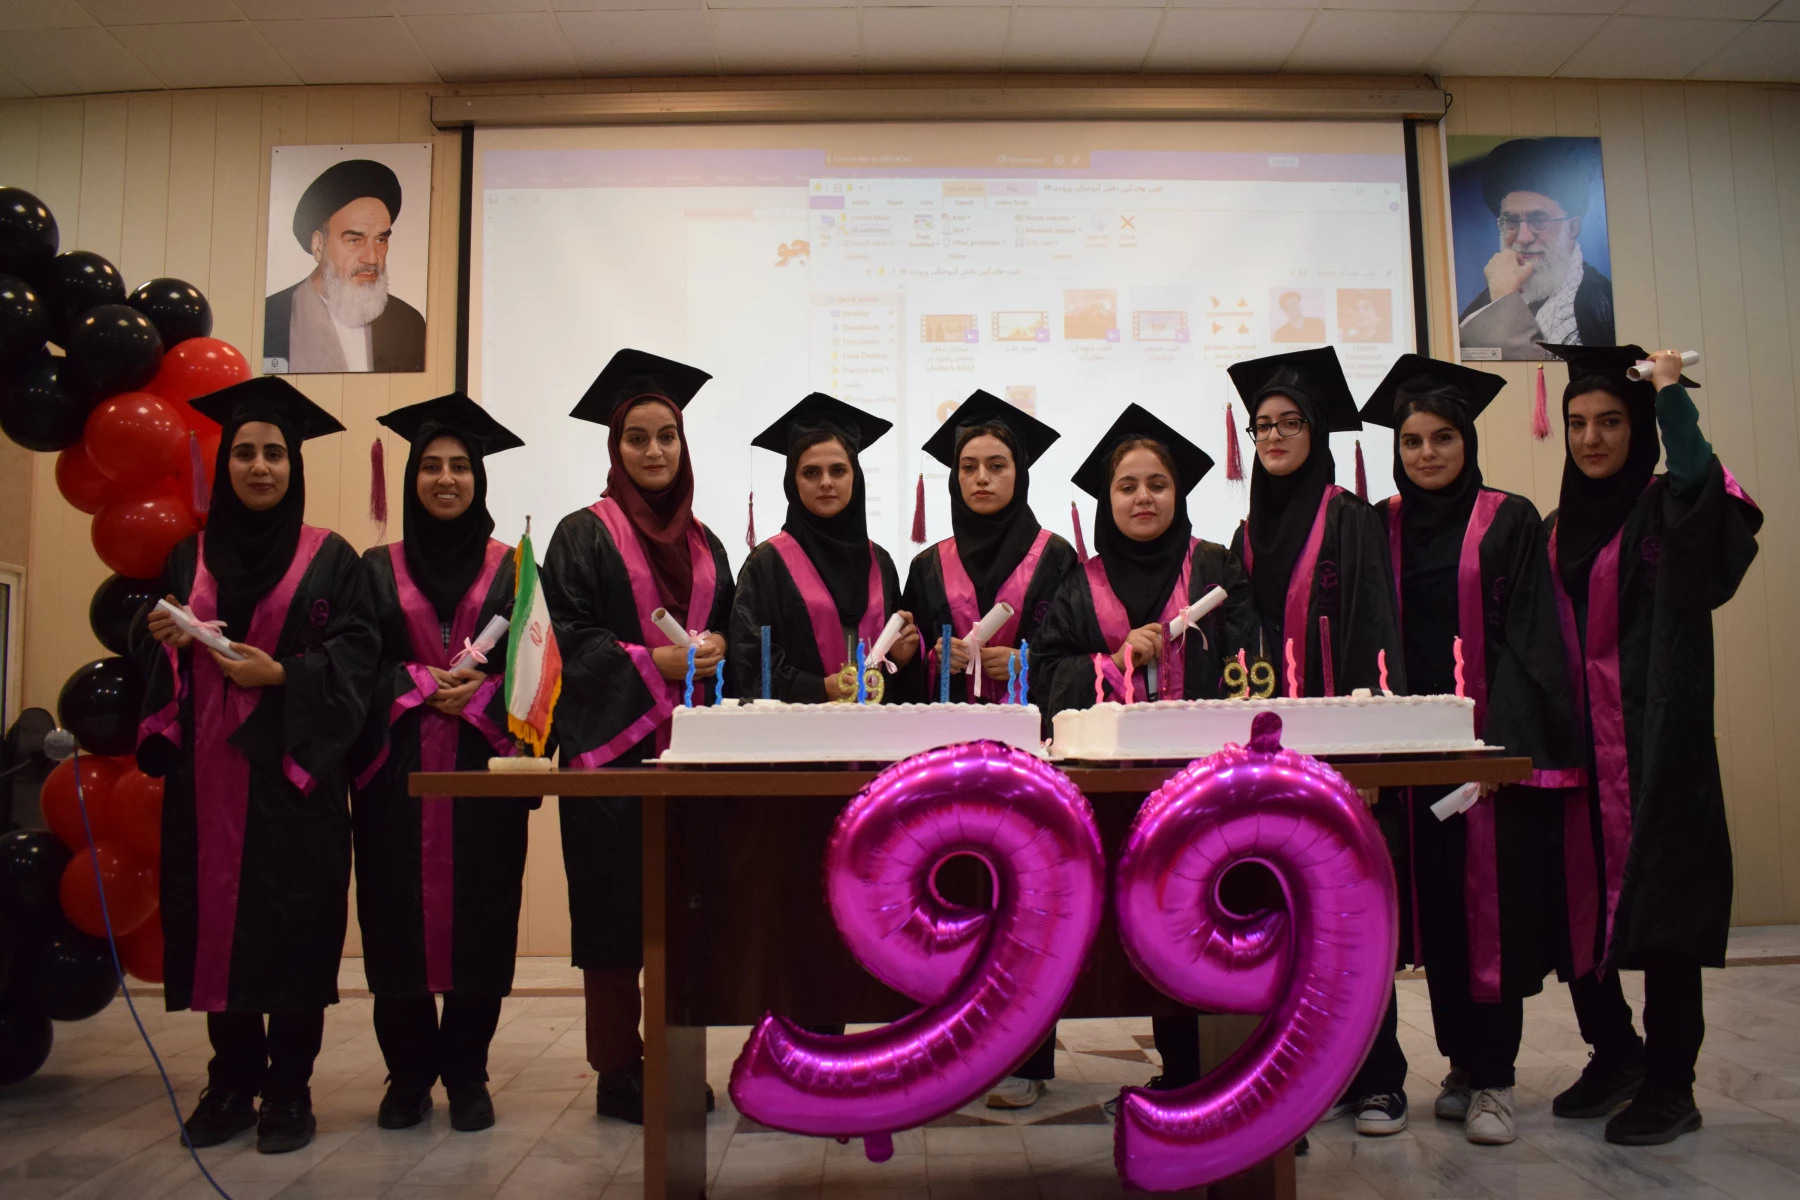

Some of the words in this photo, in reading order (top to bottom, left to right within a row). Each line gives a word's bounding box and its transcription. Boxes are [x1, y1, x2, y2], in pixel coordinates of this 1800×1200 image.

[842, 310, 870, 318] Desktop
[835, 666, 885, 705] 99
[1224, 661, 1276, 699] 99
